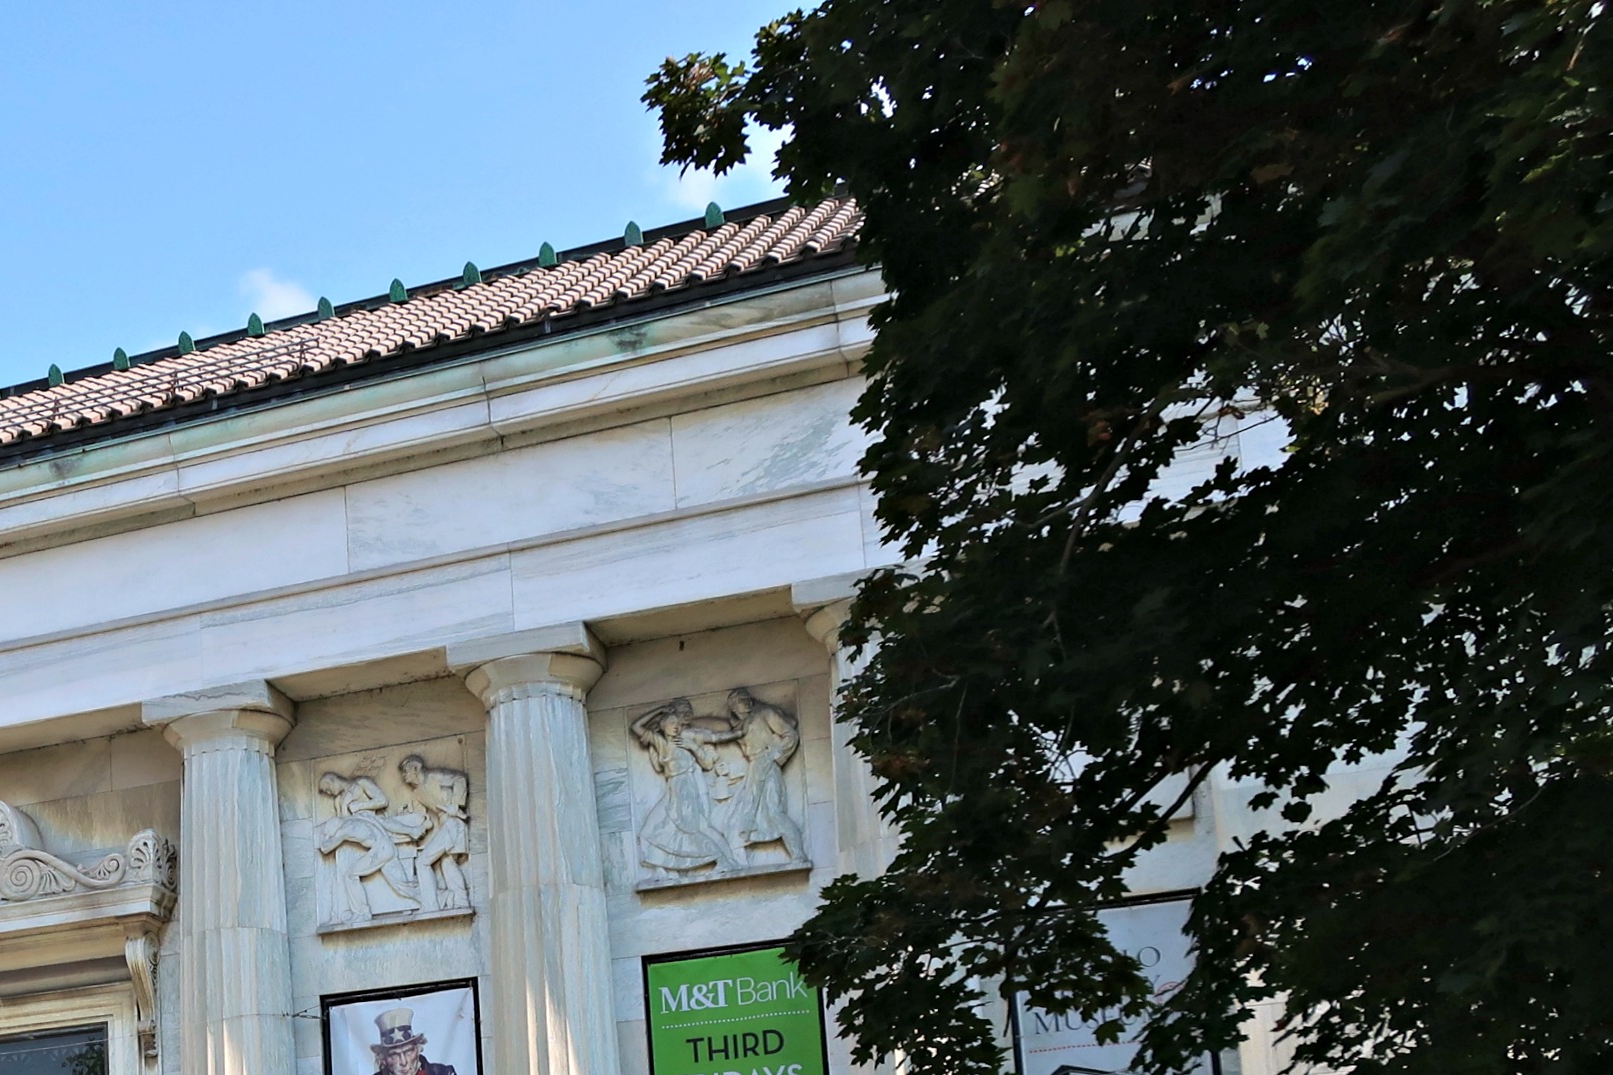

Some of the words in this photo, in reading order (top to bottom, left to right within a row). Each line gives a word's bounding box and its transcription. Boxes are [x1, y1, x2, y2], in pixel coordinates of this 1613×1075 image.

[658, 978, 733, 1014] M&T
[736, 971, 808, 1006] Bank
[685, 1029, 784, 1063] THIRD
